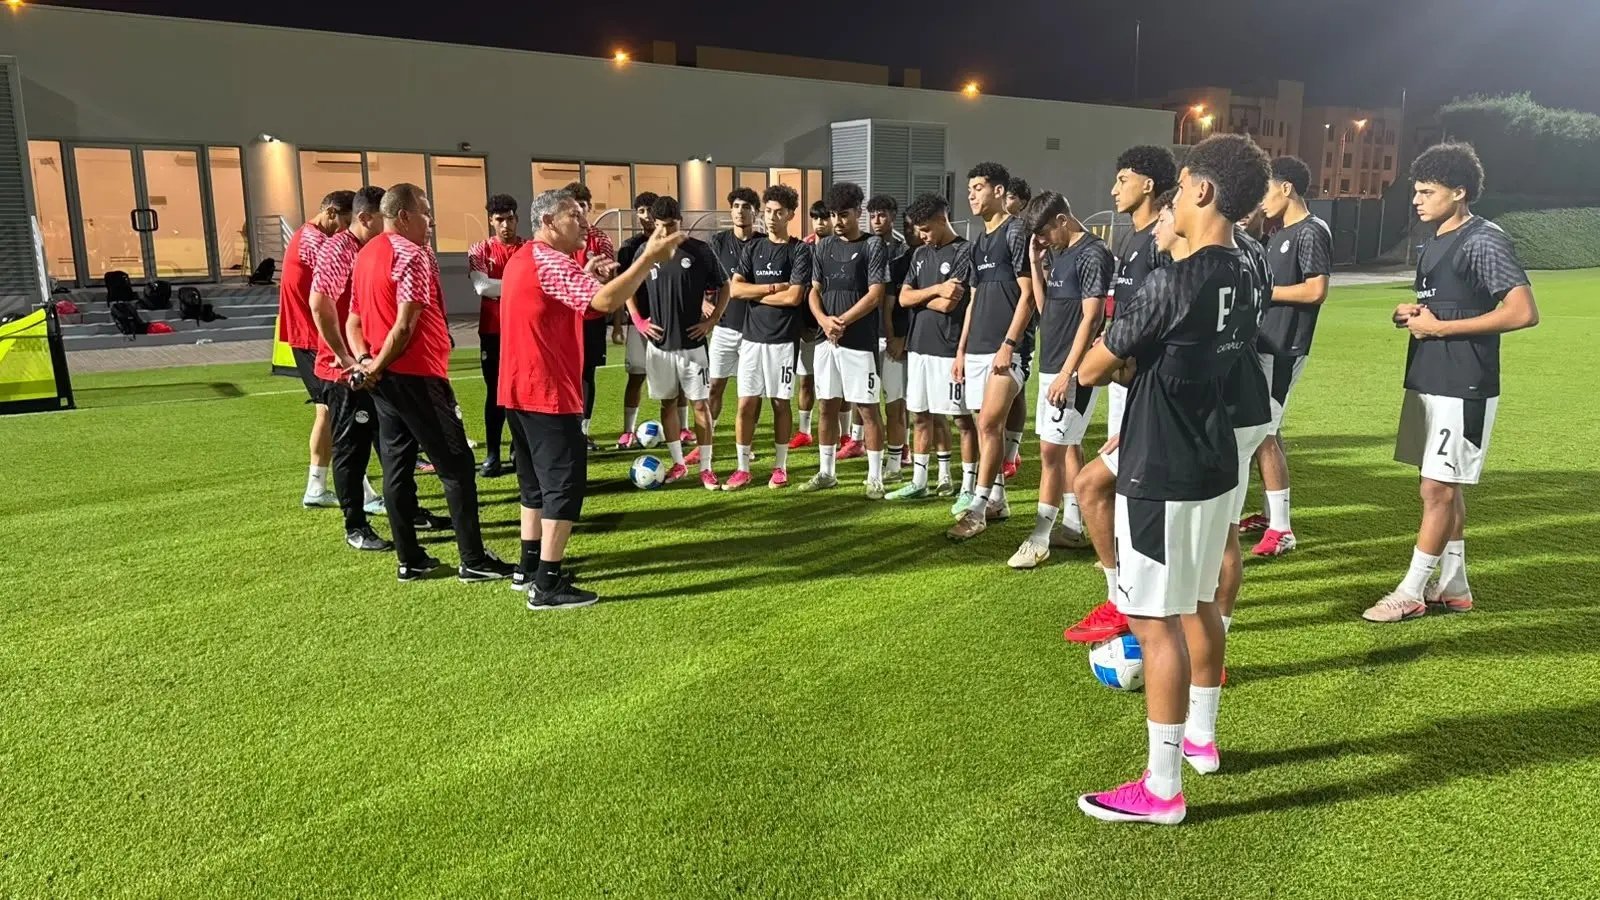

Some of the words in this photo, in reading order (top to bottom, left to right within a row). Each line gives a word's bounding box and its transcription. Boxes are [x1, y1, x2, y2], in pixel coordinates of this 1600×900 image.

[781, 365, 792, 384] 15
[868, 372, 875, 389] 5
[949, 382, 962, 401] 18
[1437, 428, 1451, 456] 2
